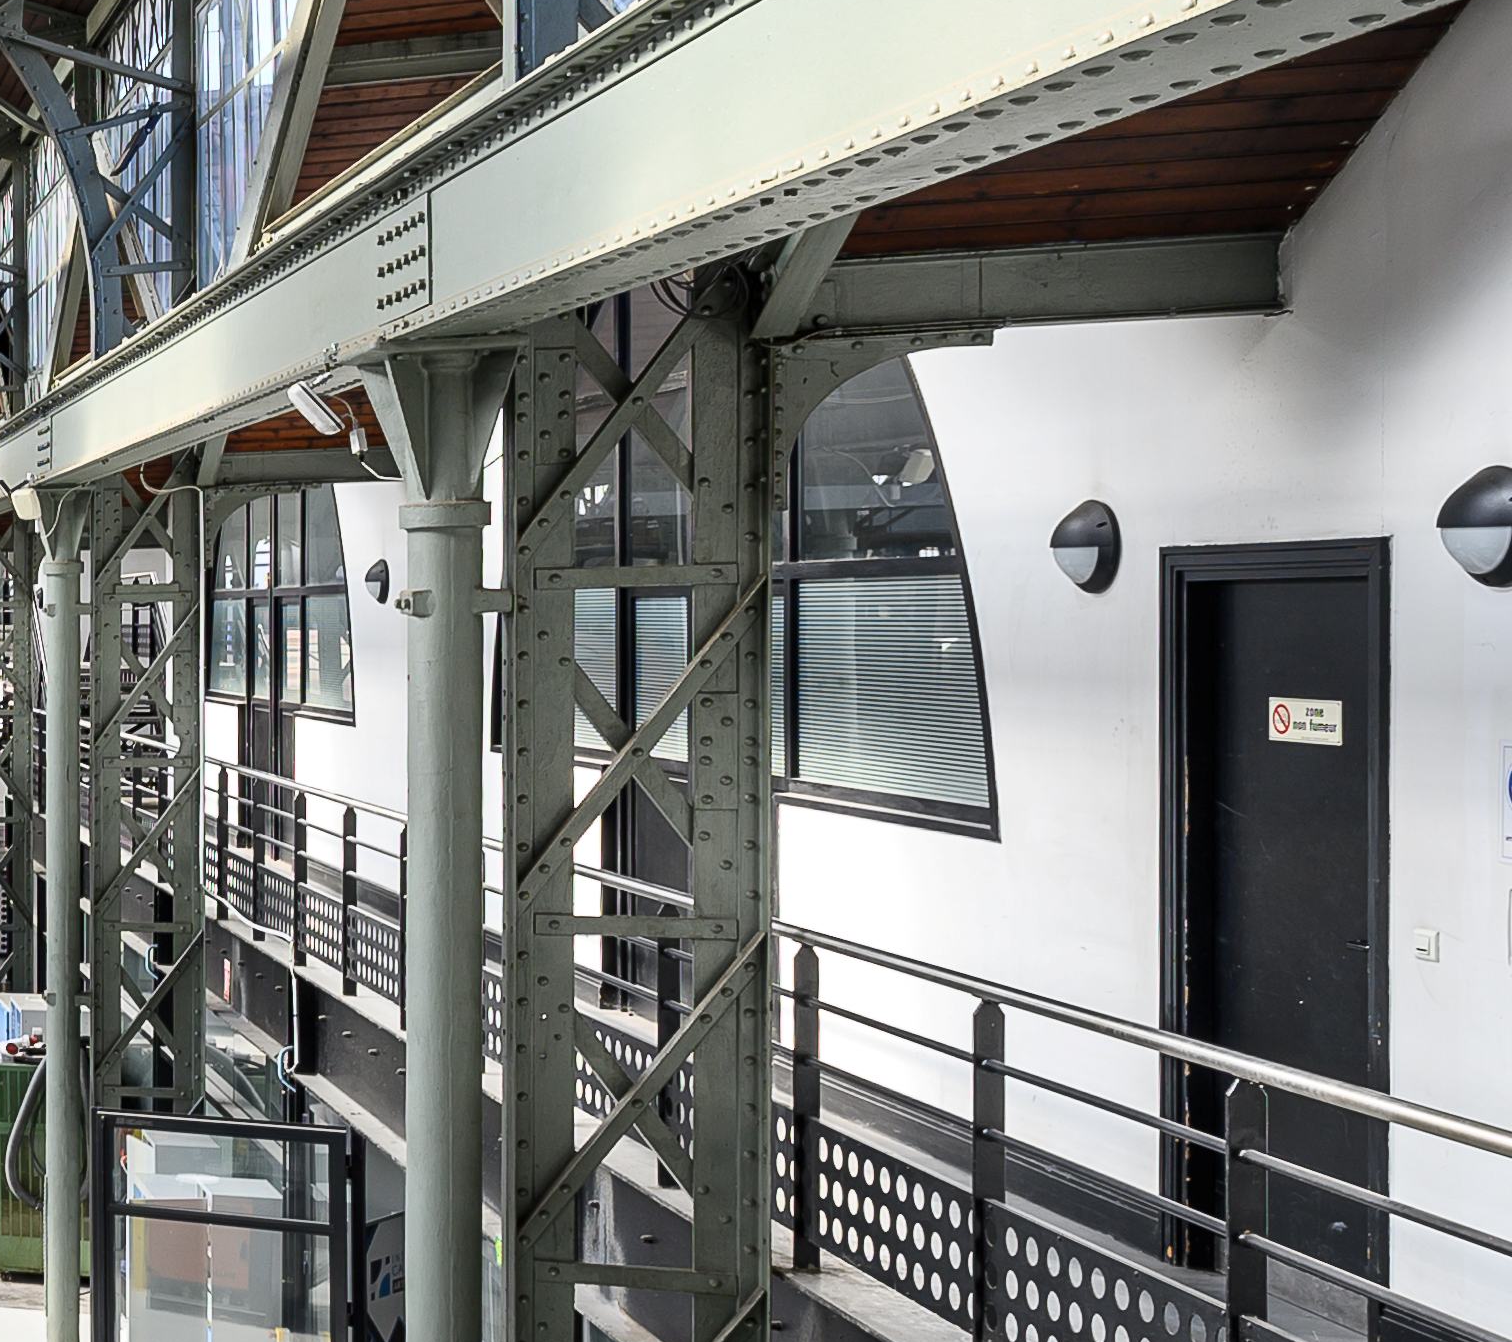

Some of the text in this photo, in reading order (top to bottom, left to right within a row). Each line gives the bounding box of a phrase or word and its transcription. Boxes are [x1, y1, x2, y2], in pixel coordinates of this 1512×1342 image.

[1305, 707, 1324, 718] zone
[1293, 718, 1337, 733] non fumeur
